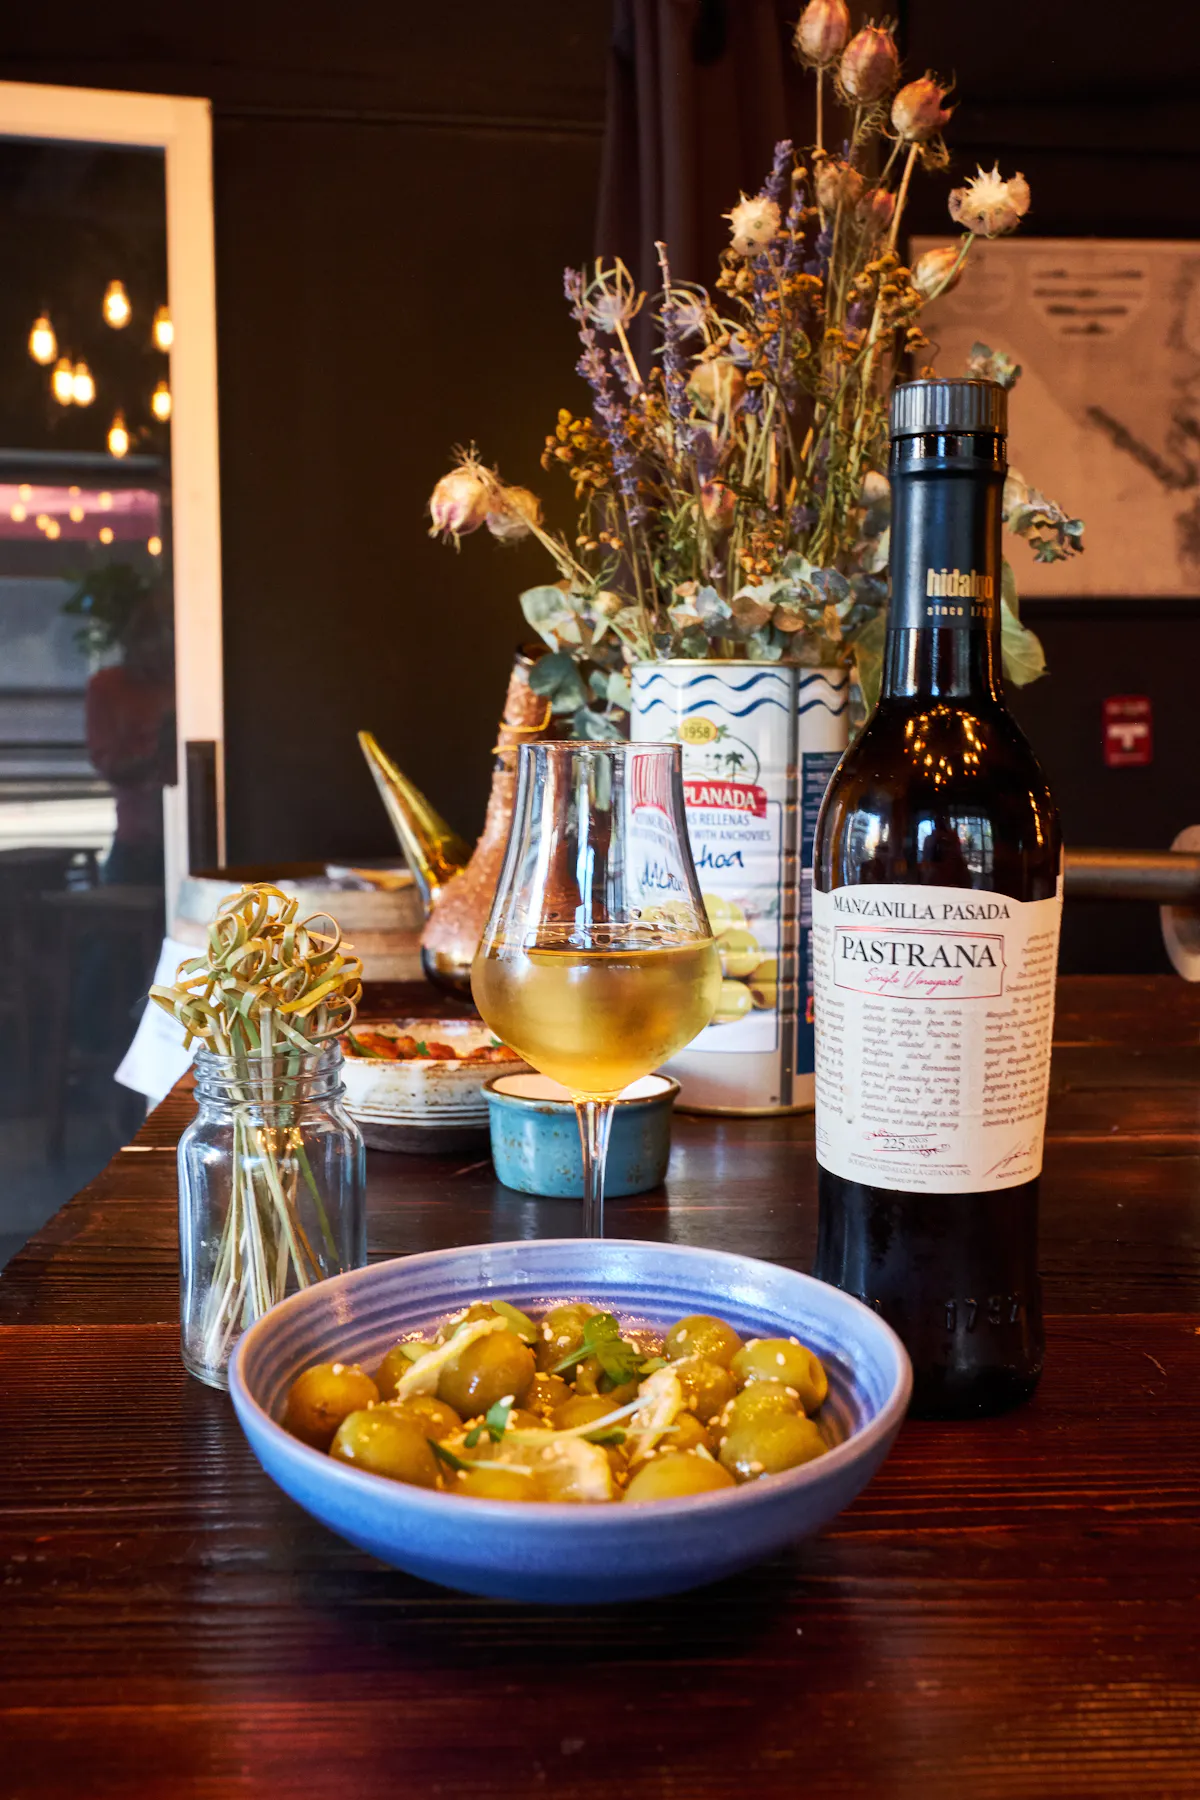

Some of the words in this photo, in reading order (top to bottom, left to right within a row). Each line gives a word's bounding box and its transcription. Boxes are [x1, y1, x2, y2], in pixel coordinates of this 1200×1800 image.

[926, 567, 993, 602] hidalgo
[926, 604, 964, 616] since
[684, 726, 710, 739] 1958
[683, 785, 757, 810] PLANADA
[699, 812, 750, 826] RELLENAS
[694, 829, 717, 839] WITH
[720, 829, 772, 841] ANCHOVIES
[833, 895, 935, 920] MANZANILLA
[942, 903, 1011, 920] PASADA
[841, 935, 997, 968] PASTRANA
[864, 966, 900, 991] Single
[903, 969, 964, 996] Vineyard
[882, 1138, 906, 1151] 225
